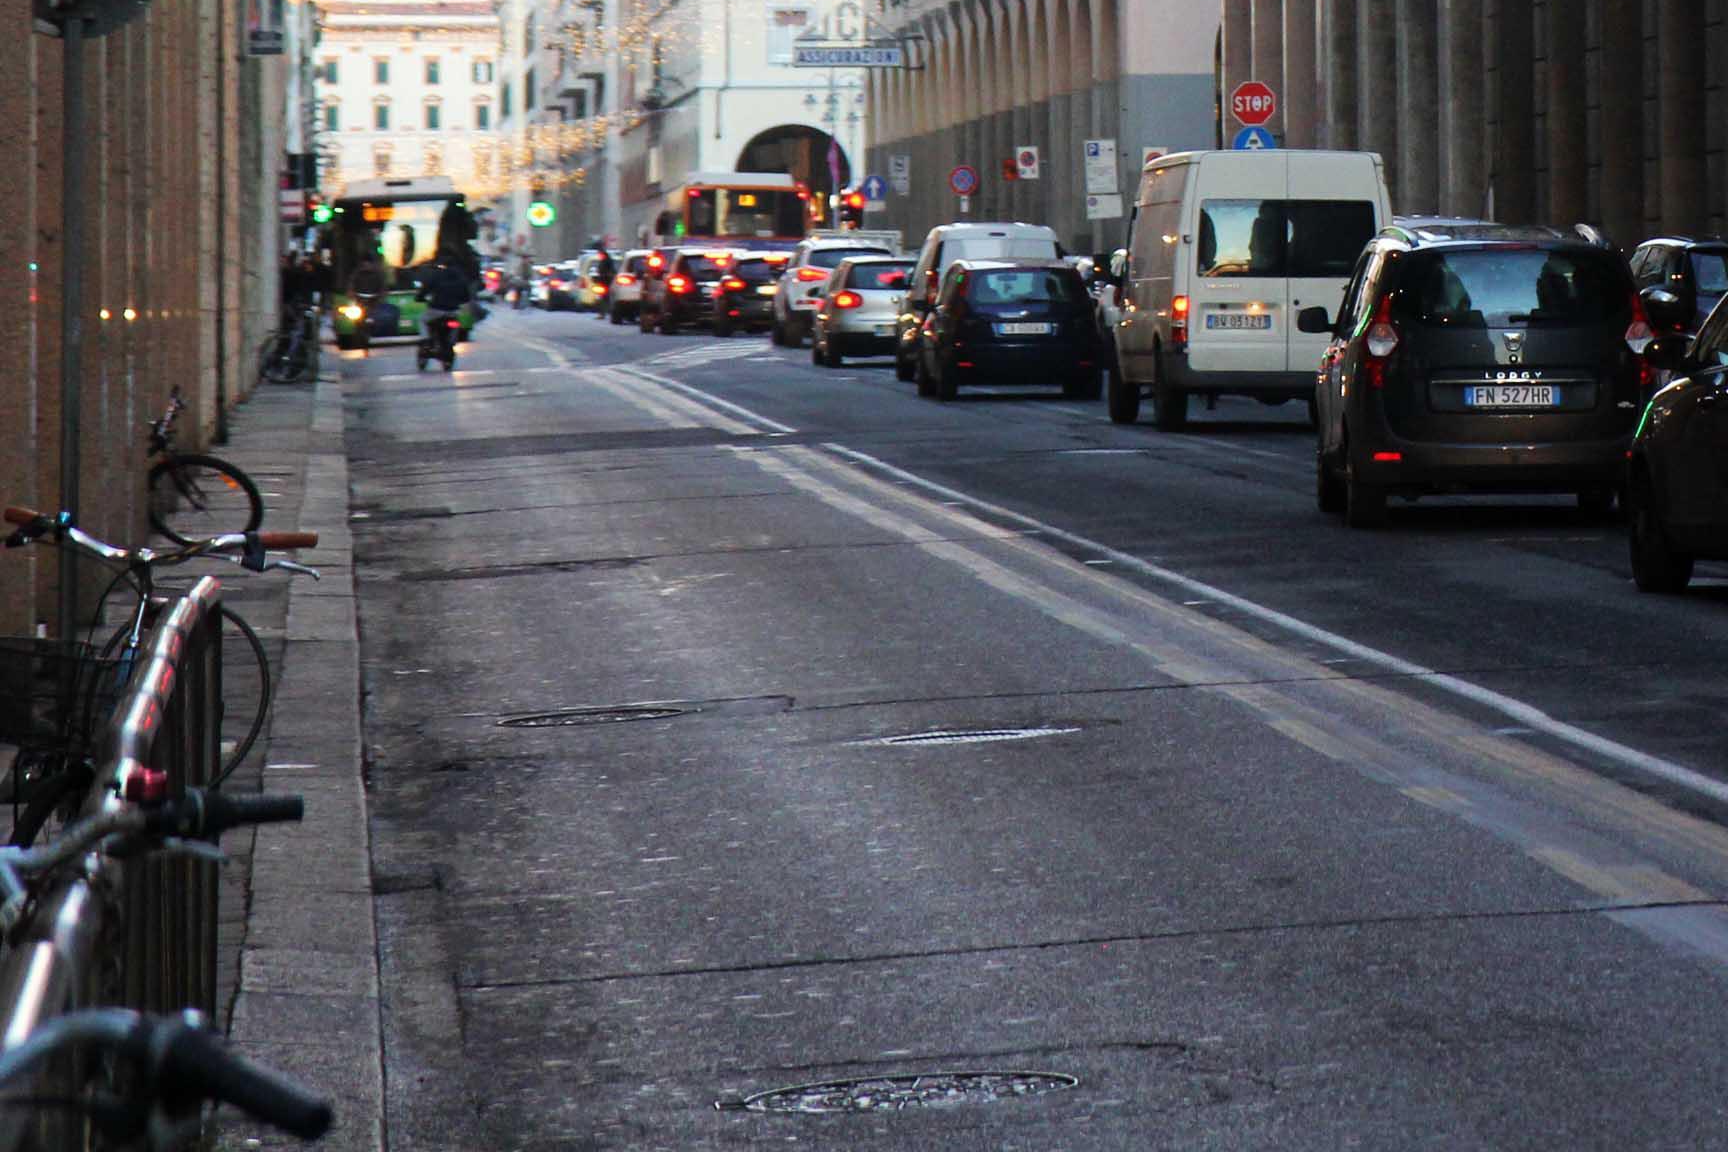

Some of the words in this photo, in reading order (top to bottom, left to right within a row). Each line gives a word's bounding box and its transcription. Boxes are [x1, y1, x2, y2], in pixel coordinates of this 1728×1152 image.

[1235, 95, 1271, 112] STOP
[1485, 371, 1542, 379] LODGY
[1476, 388, 1495, 403] FN
[1502, 387, 1551, 403] 527HR
